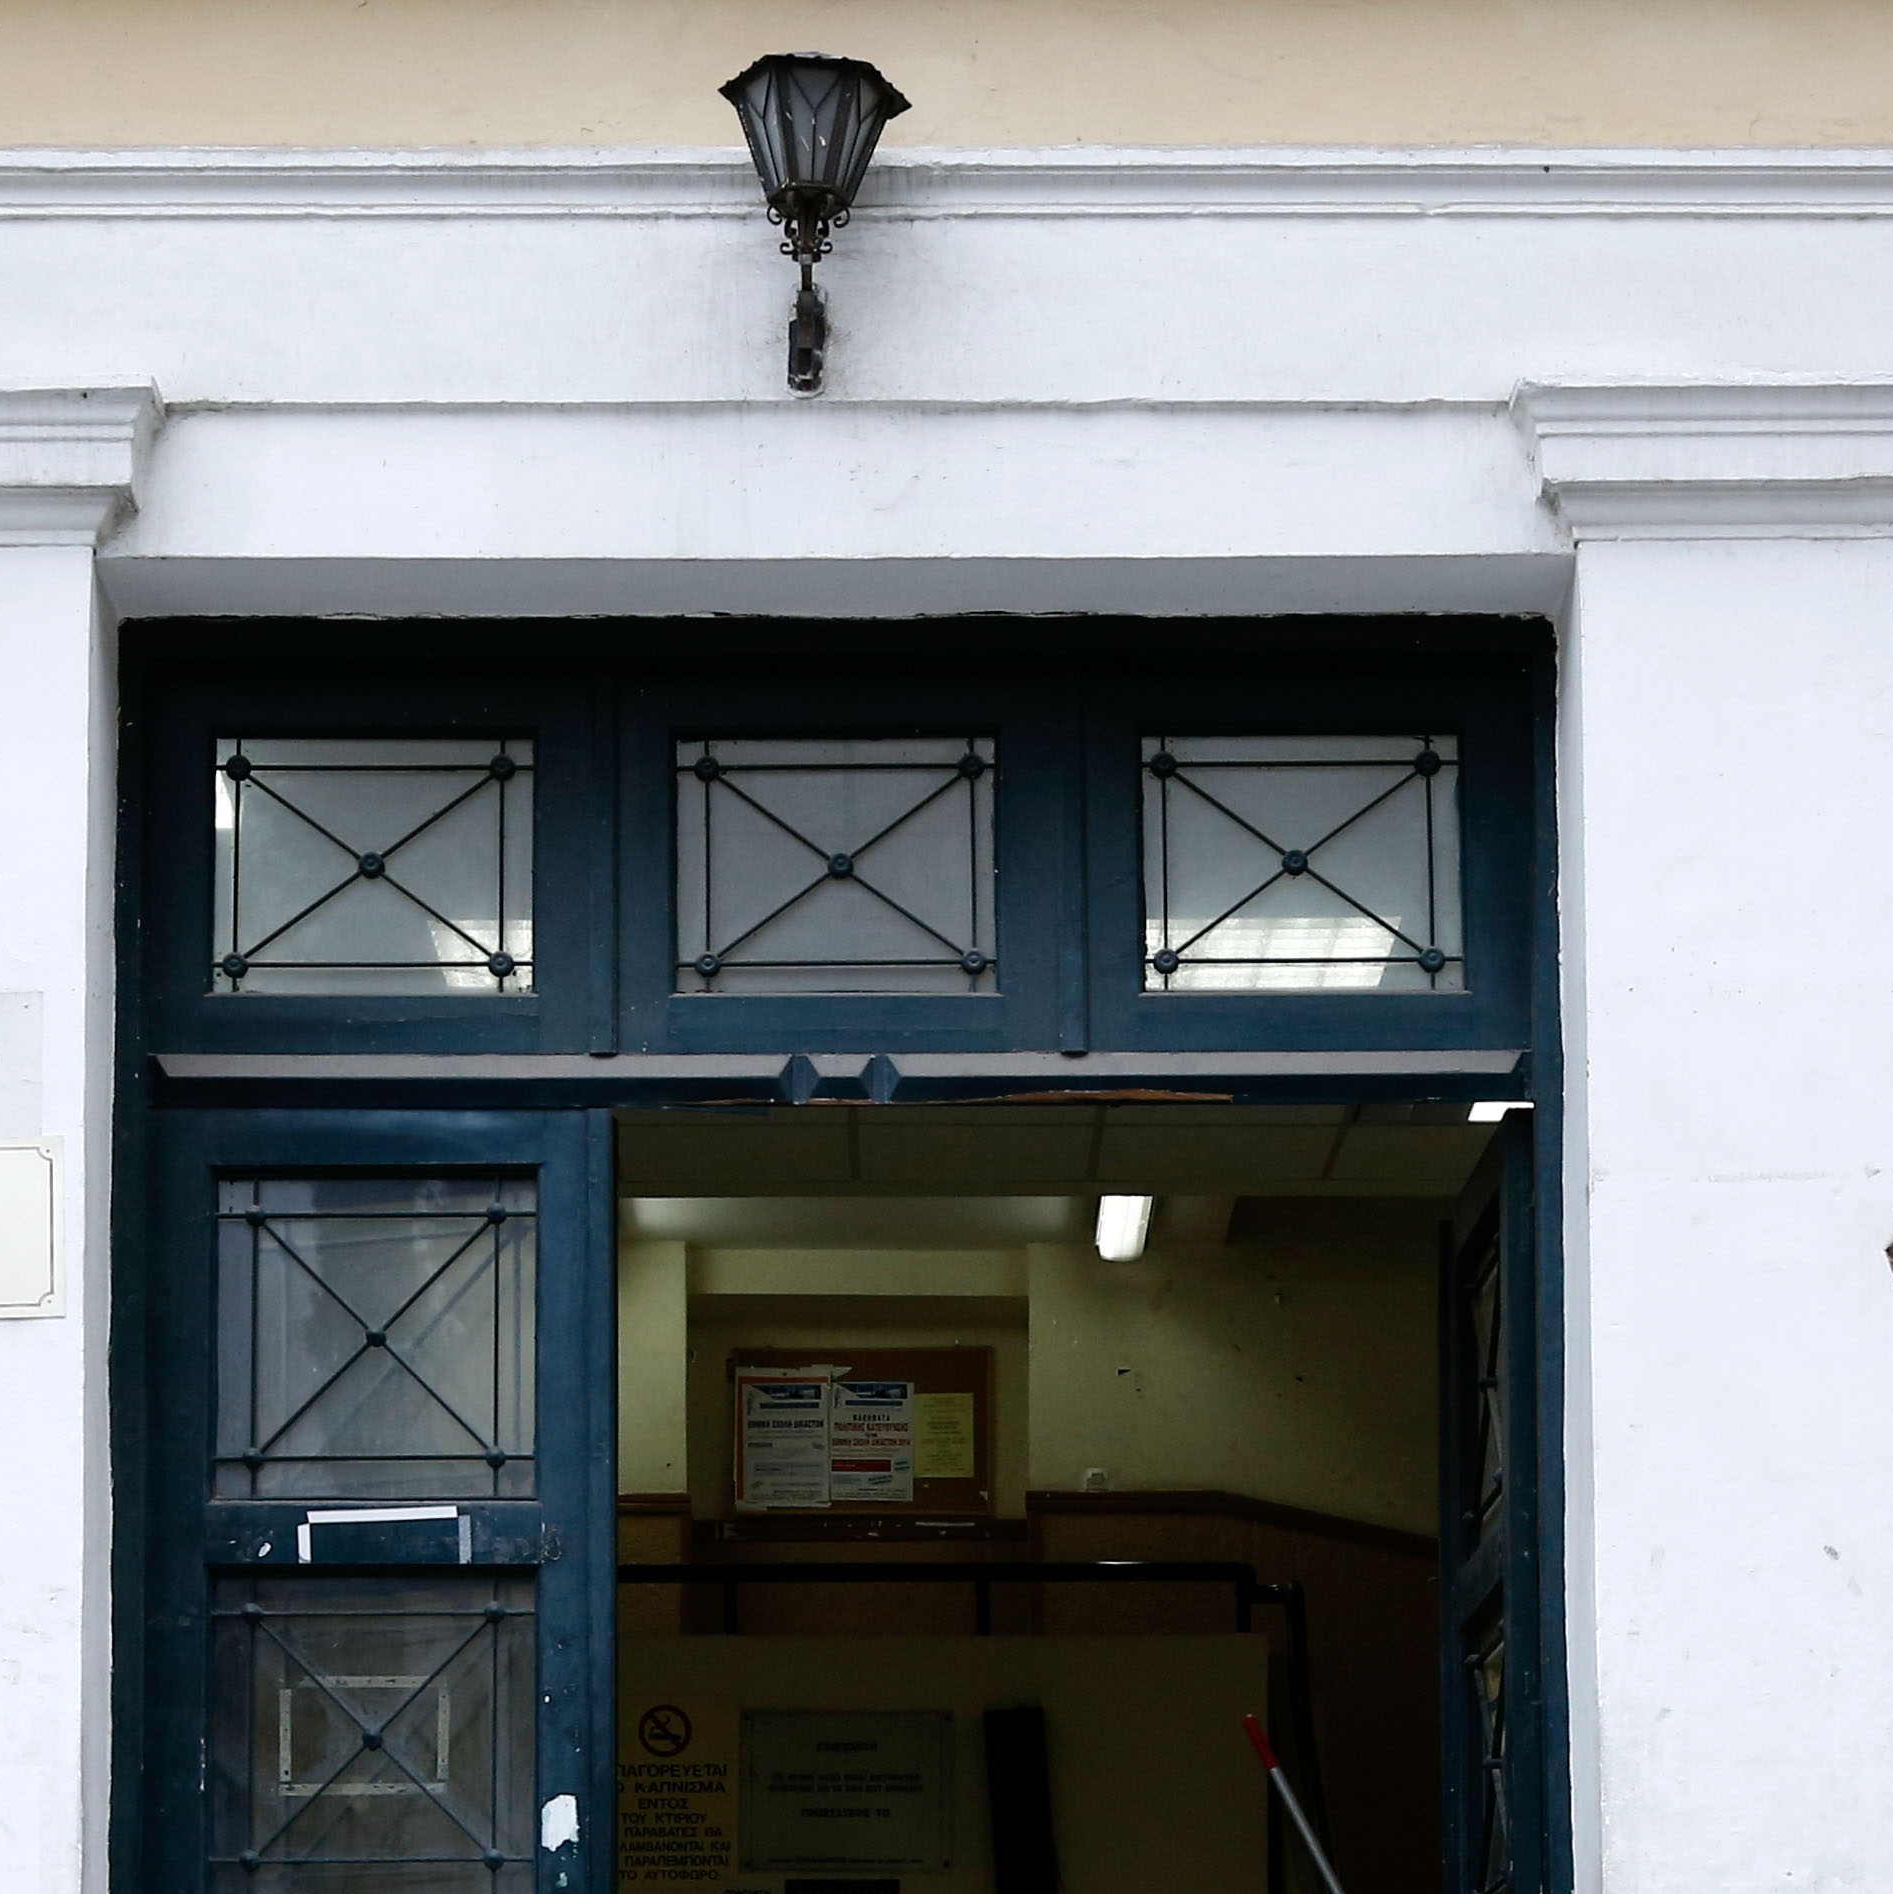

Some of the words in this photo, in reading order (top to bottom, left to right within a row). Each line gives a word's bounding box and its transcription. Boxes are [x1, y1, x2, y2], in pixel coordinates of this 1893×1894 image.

[618, 1764, 727, 1777] ΠΑΓΟΡΕΥΕΤΑΙ
[635, 1781, 726, 1793] ΚΑΠΝΙΣΜΑ
[638, 1797, 689, 1809] ΕΝΤΟΣ
[621, 1813, 647, 1824] ΤΟΥ
[655, 1813, 708, 1824] ΚΤΙΡΙΟΥ
[624, 1826, 698, 1837] ΠΑΡΑΒΑΤΕΣ
[704, 1826, 722, 1837] ΘΑ
[620, 1841, 704, 1851] ΛΑΜΒΑΝΟΝΤΑΙ
[710, 1841, 731, 1851] ΚΑΙ
[625, 1855, 729, 1866] ΠΑΡΑΠΕΜΠΟΝΤΑΙ
[618, 1870, 638, 1880] ΤΟ
[644, 1869, 719, 1880] ΑΥΤΟΦΩΡΟ
